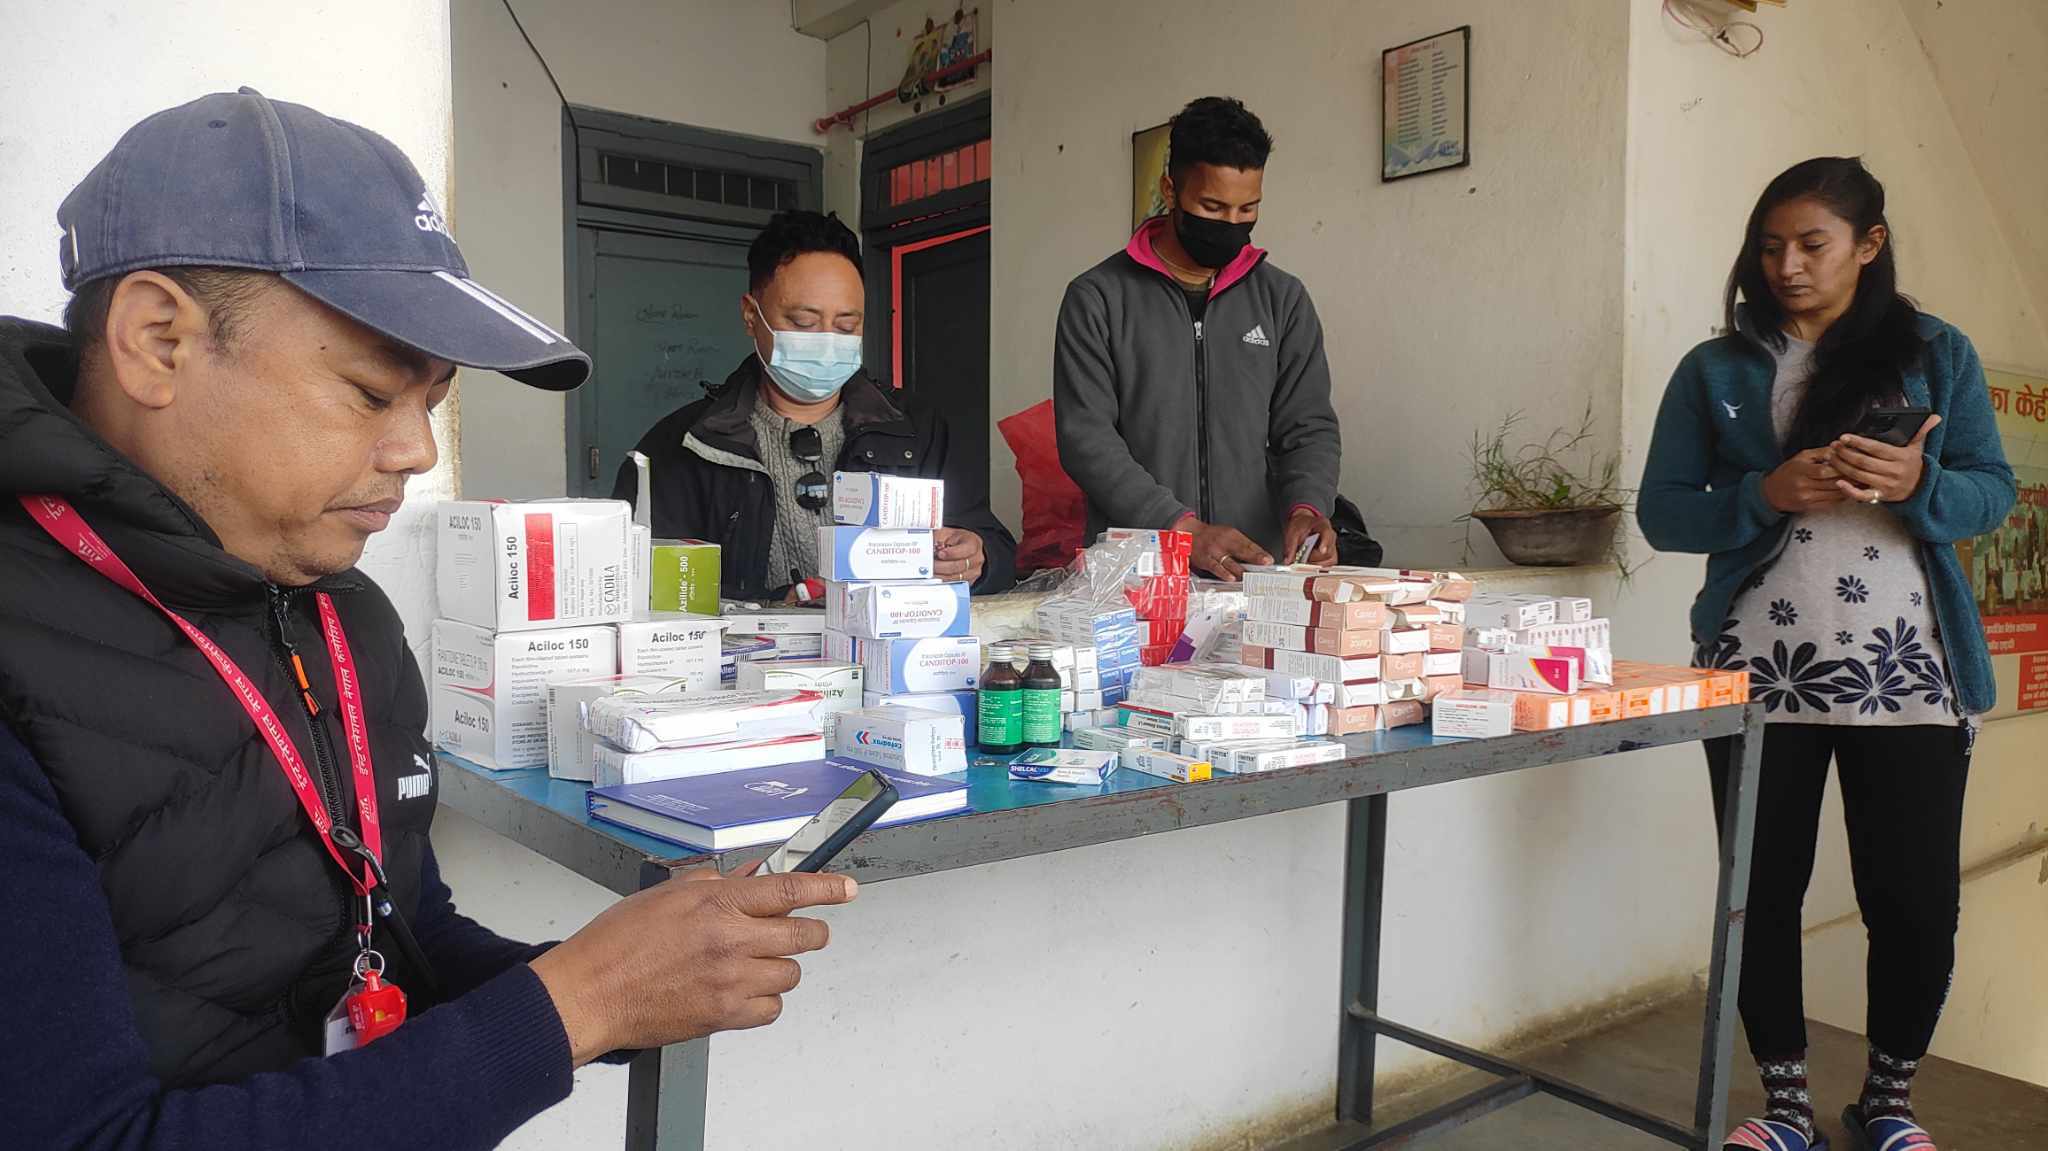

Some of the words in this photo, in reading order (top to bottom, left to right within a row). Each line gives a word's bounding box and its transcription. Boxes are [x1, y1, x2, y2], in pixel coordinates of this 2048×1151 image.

[1242, 335, 1270, 347] adidas
[471, 517, 481, 531] 150
[506, 536, 518, 561] 150
[680, 556, 688, 572] 500
[508, 562, 519, 600] Aciloc
[604, 564, 616, 603] CADILA
[527, 640, 565, 652] Aciloc
[568, 638, 589, 650] 150
[652, 632, 685, 644] Aciloc
[688, 630, 706, 641] 150
[454, 709, 476, 729] Aciloc
[478, 713, 490, 733] 150
[398, 773, 430, 800] PUMA
